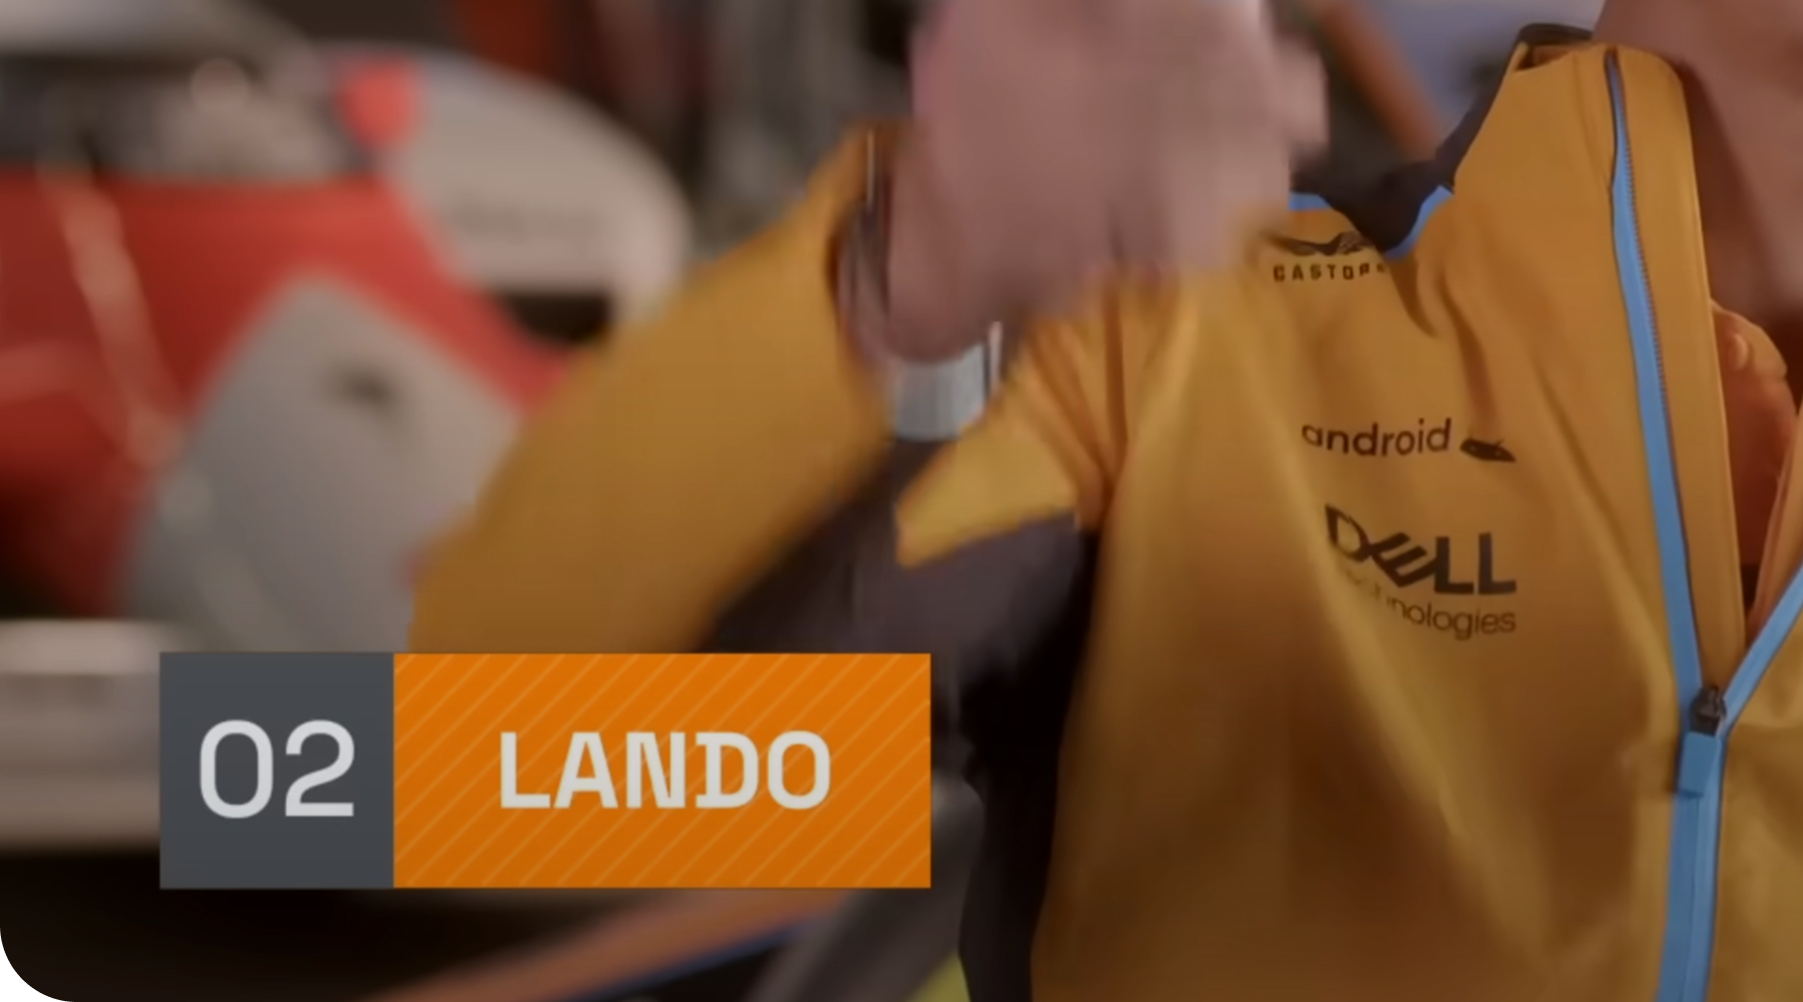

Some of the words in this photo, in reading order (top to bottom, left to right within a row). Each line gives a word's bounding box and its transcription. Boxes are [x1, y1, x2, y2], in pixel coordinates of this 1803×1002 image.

[1301, 418, 1452, 458] android
[1325, 504, 1518, 596] DELL
[1340, 566, 1517, 641] nologies
